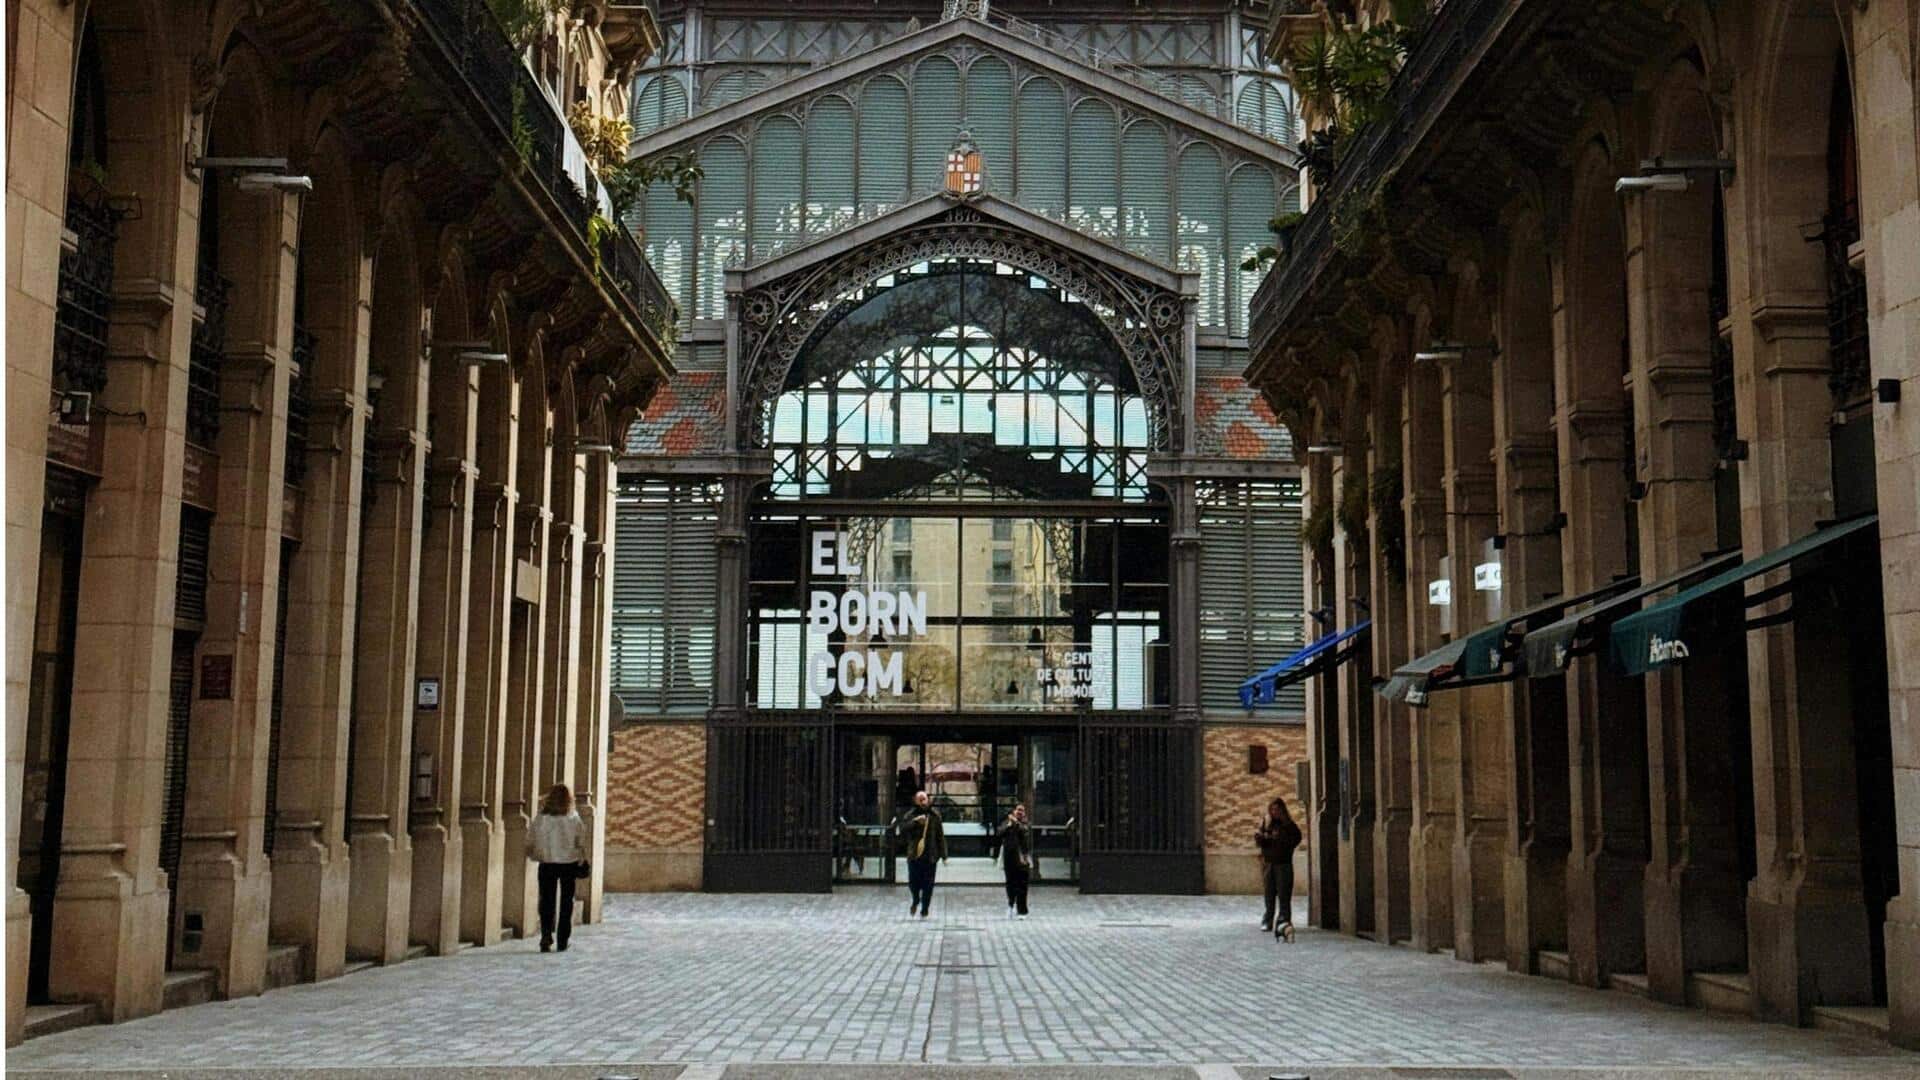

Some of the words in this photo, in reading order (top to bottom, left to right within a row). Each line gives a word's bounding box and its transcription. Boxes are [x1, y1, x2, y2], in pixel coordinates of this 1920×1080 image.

[811, 531, 862, 575] EL
[810, 590, 927, 636] BORN
[1064, 652, 1105, 665] CENT
[809, 651, 904, 697] CCM
[1037, 668, 1052, 681] DE
[1055, 668, 1105, 681] CULTU
[1054, 684, 1105, 697] MEMÒ
